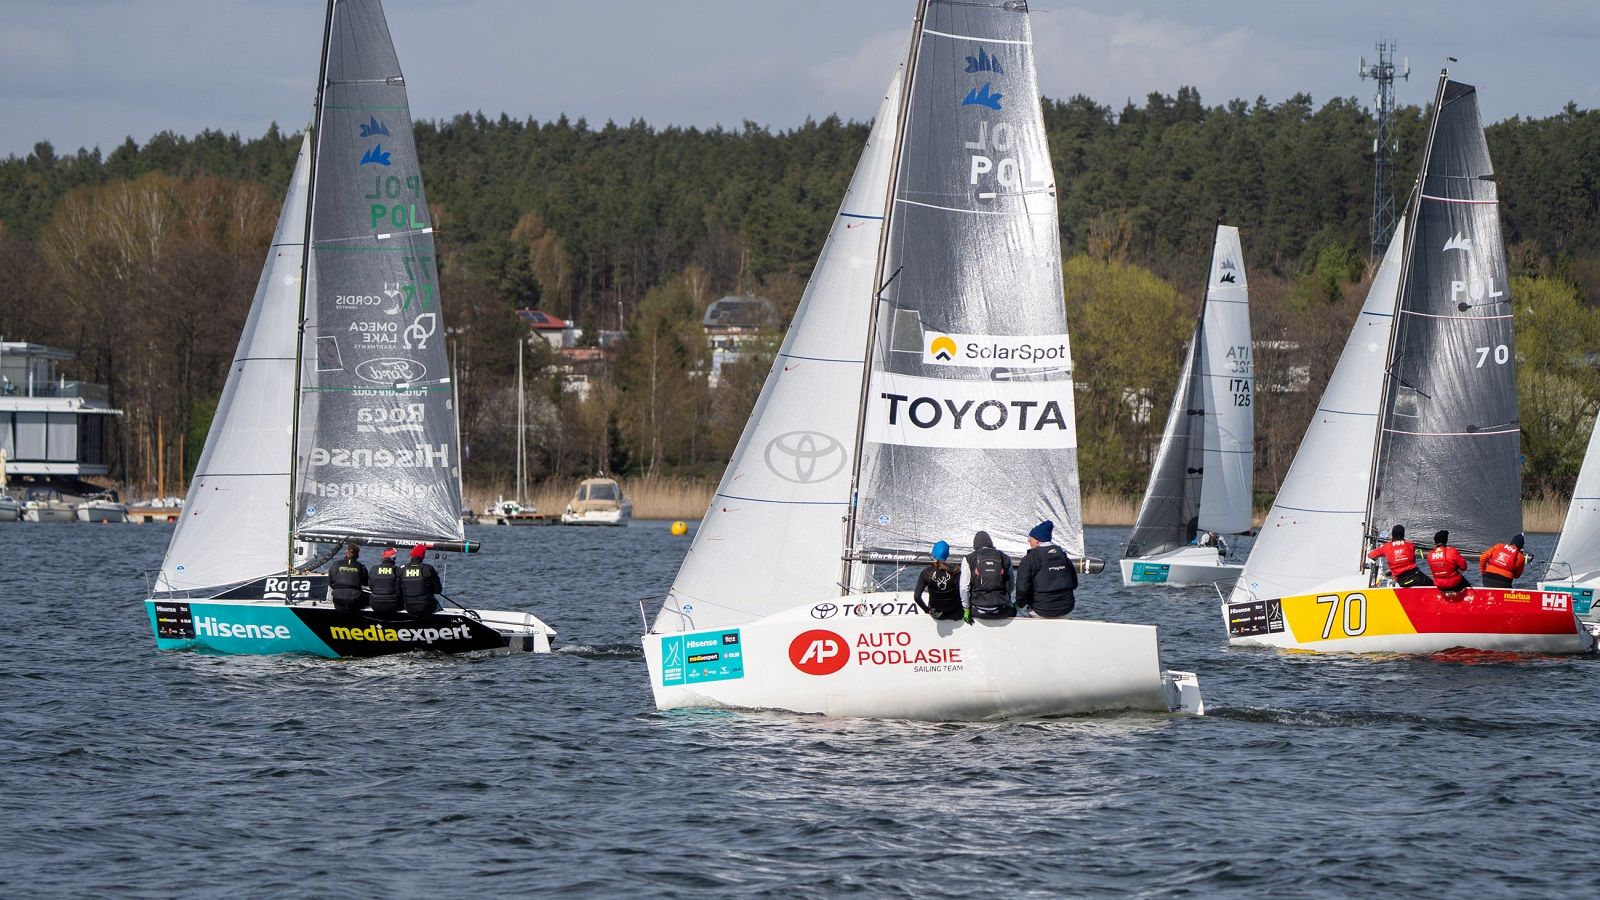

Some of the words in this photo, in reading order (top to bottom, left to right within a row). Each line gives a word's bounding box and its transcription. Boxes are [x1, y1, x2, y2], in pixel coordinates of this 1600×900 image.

[970, 155, 1044, 188] POL
[370, 203, 425, 230] POL
[1451, 277, 1503, 301] POL
[965, 343, 1066, 363] SolarSpot
[1475, 344, 1509, 369] 70
[1229, 378, 1250, 393] ITA
[1233, 393, 1251, 407] 125
[881, 392, 1067, 431] TOYOTA
[1432, 551, 1444, 560] HH
[378, 567, 392, 575] HH
[405, 569, 420, 577] HH
[264, 577, 311, 592] Roca
[1541, 593, 1567, 608] HH
[842, 602, 919, 617] TOYOTA
[1315, 592, 1368, 640] 70
[194, 615, 291, 639] Hisense
[329, 623, 473, 644] mediaexpert
[686, 640, 718, 649] Hisense
[856, 631, 912, 648] AUTO
[798, 639, 839, 665] AP
[858, 648, 963, 665] PODLASIE
[913, 665, 942, 673] SAILING
